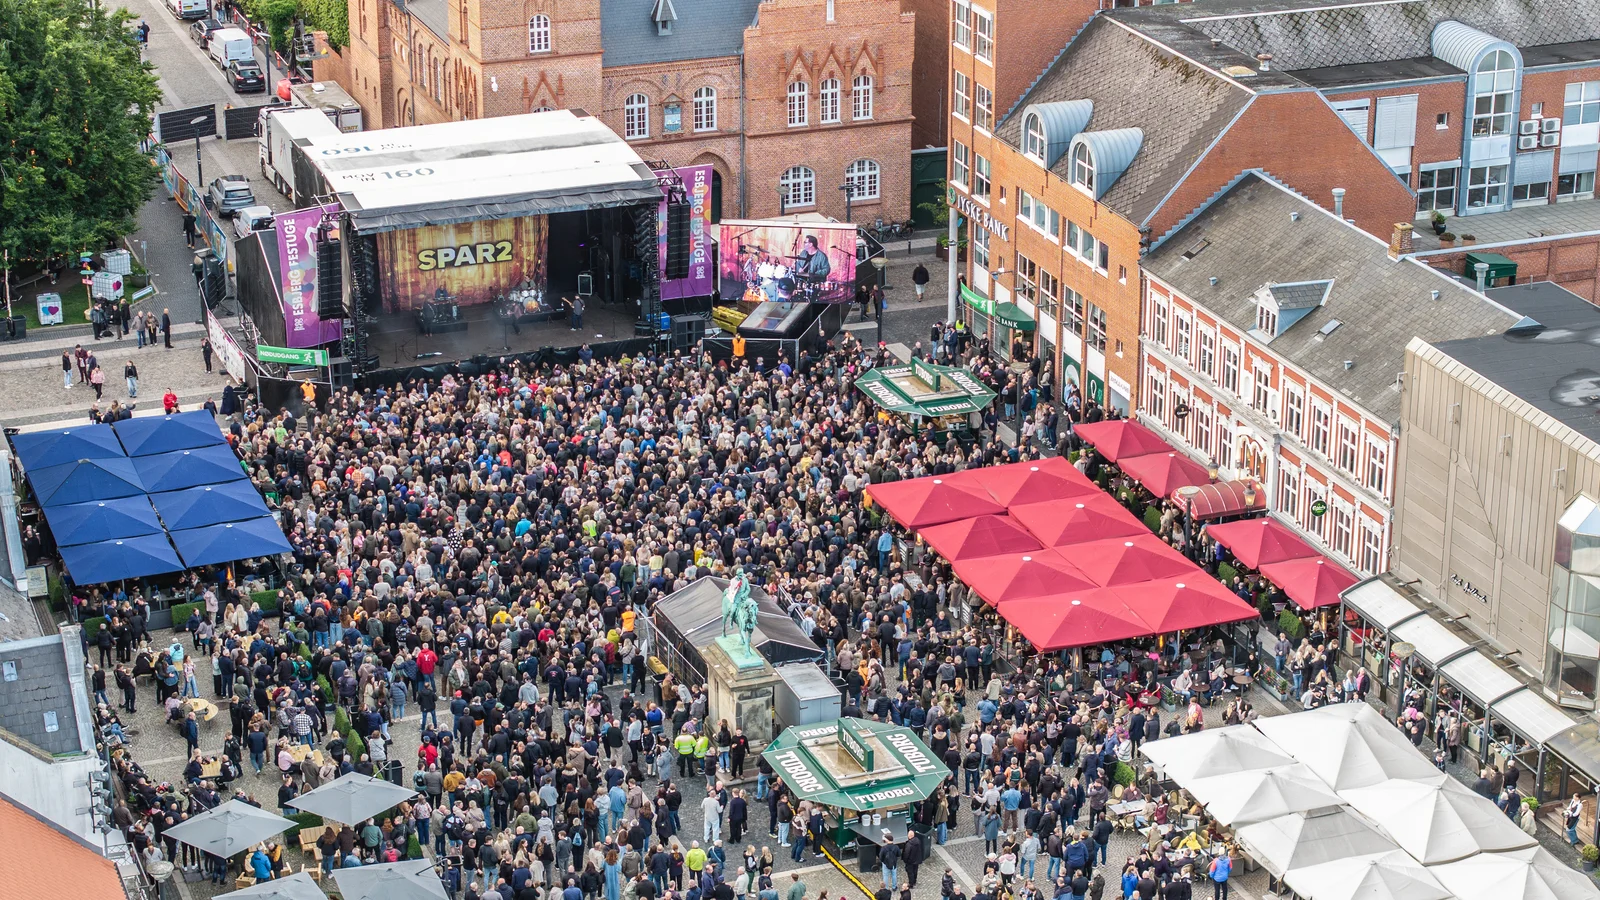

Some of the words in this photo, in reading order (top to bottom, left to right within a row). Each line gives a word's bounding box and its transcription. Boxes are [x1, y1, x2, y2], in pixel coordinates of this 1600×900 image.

[380, 167, 435, 180] 160
[693, 169, 706, 215] ESBJERG
[957, 194, 983, 223] JYSKE
[983, 213, 1010, 242] BANK
[284, 218, 299, 267] FESTUGE
[417, 240, 513, 271] SPAR2
[693, 217, 705, 264] FESTUGE
[290, 268, 304, 316] ESBJERG
[1001, 317, 1018, 329] BANK
[864, 380, 903, 406] TUBORG
[947, 371, 987, 396] TUBORG
[926, 402, 972, 413] TUBORG
[799, 724, 838, 737] BORG
[842, 728, 865, 762] TUBORG
[886, 733, 937, 773] TUBORG
[775, 751, 824, 793] TUBORG
[855, 786, 914, 804] TUBORG
